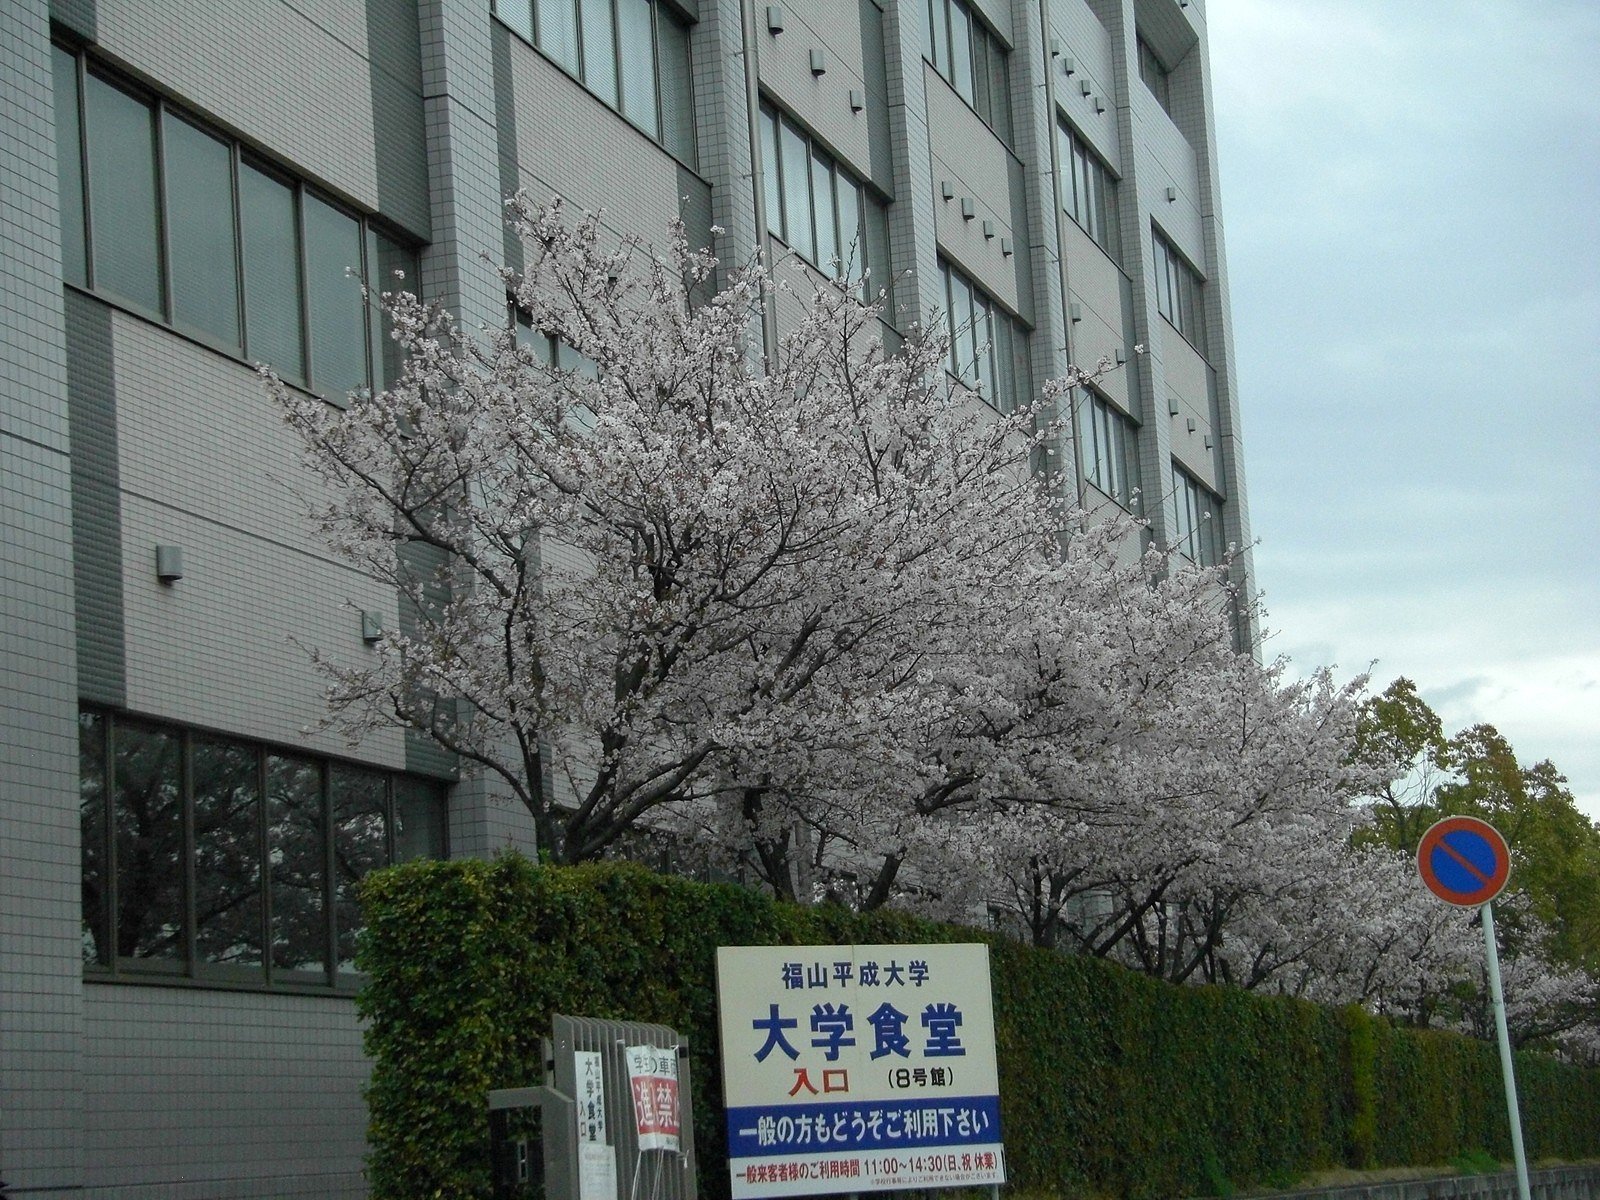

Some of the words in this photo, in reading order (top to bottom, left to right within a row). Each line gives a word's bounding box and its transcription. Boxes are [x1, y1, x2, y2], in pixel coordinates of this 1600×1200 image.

[782, 960, 930, 990] 福山平成大学
[752, 1002, 966, 1063] 大学食堂
[788, 1068, 850, 1096] 入口
[888, 1067, 954, 1089] (8号館)
[585, 1057, 597, 1141] 大学食堂
[739, 1108, 989, 1146] 一般の方もどうぞご利用下さい
[736, 1159, 860, 1184] 一般来客者様のご利用時間
